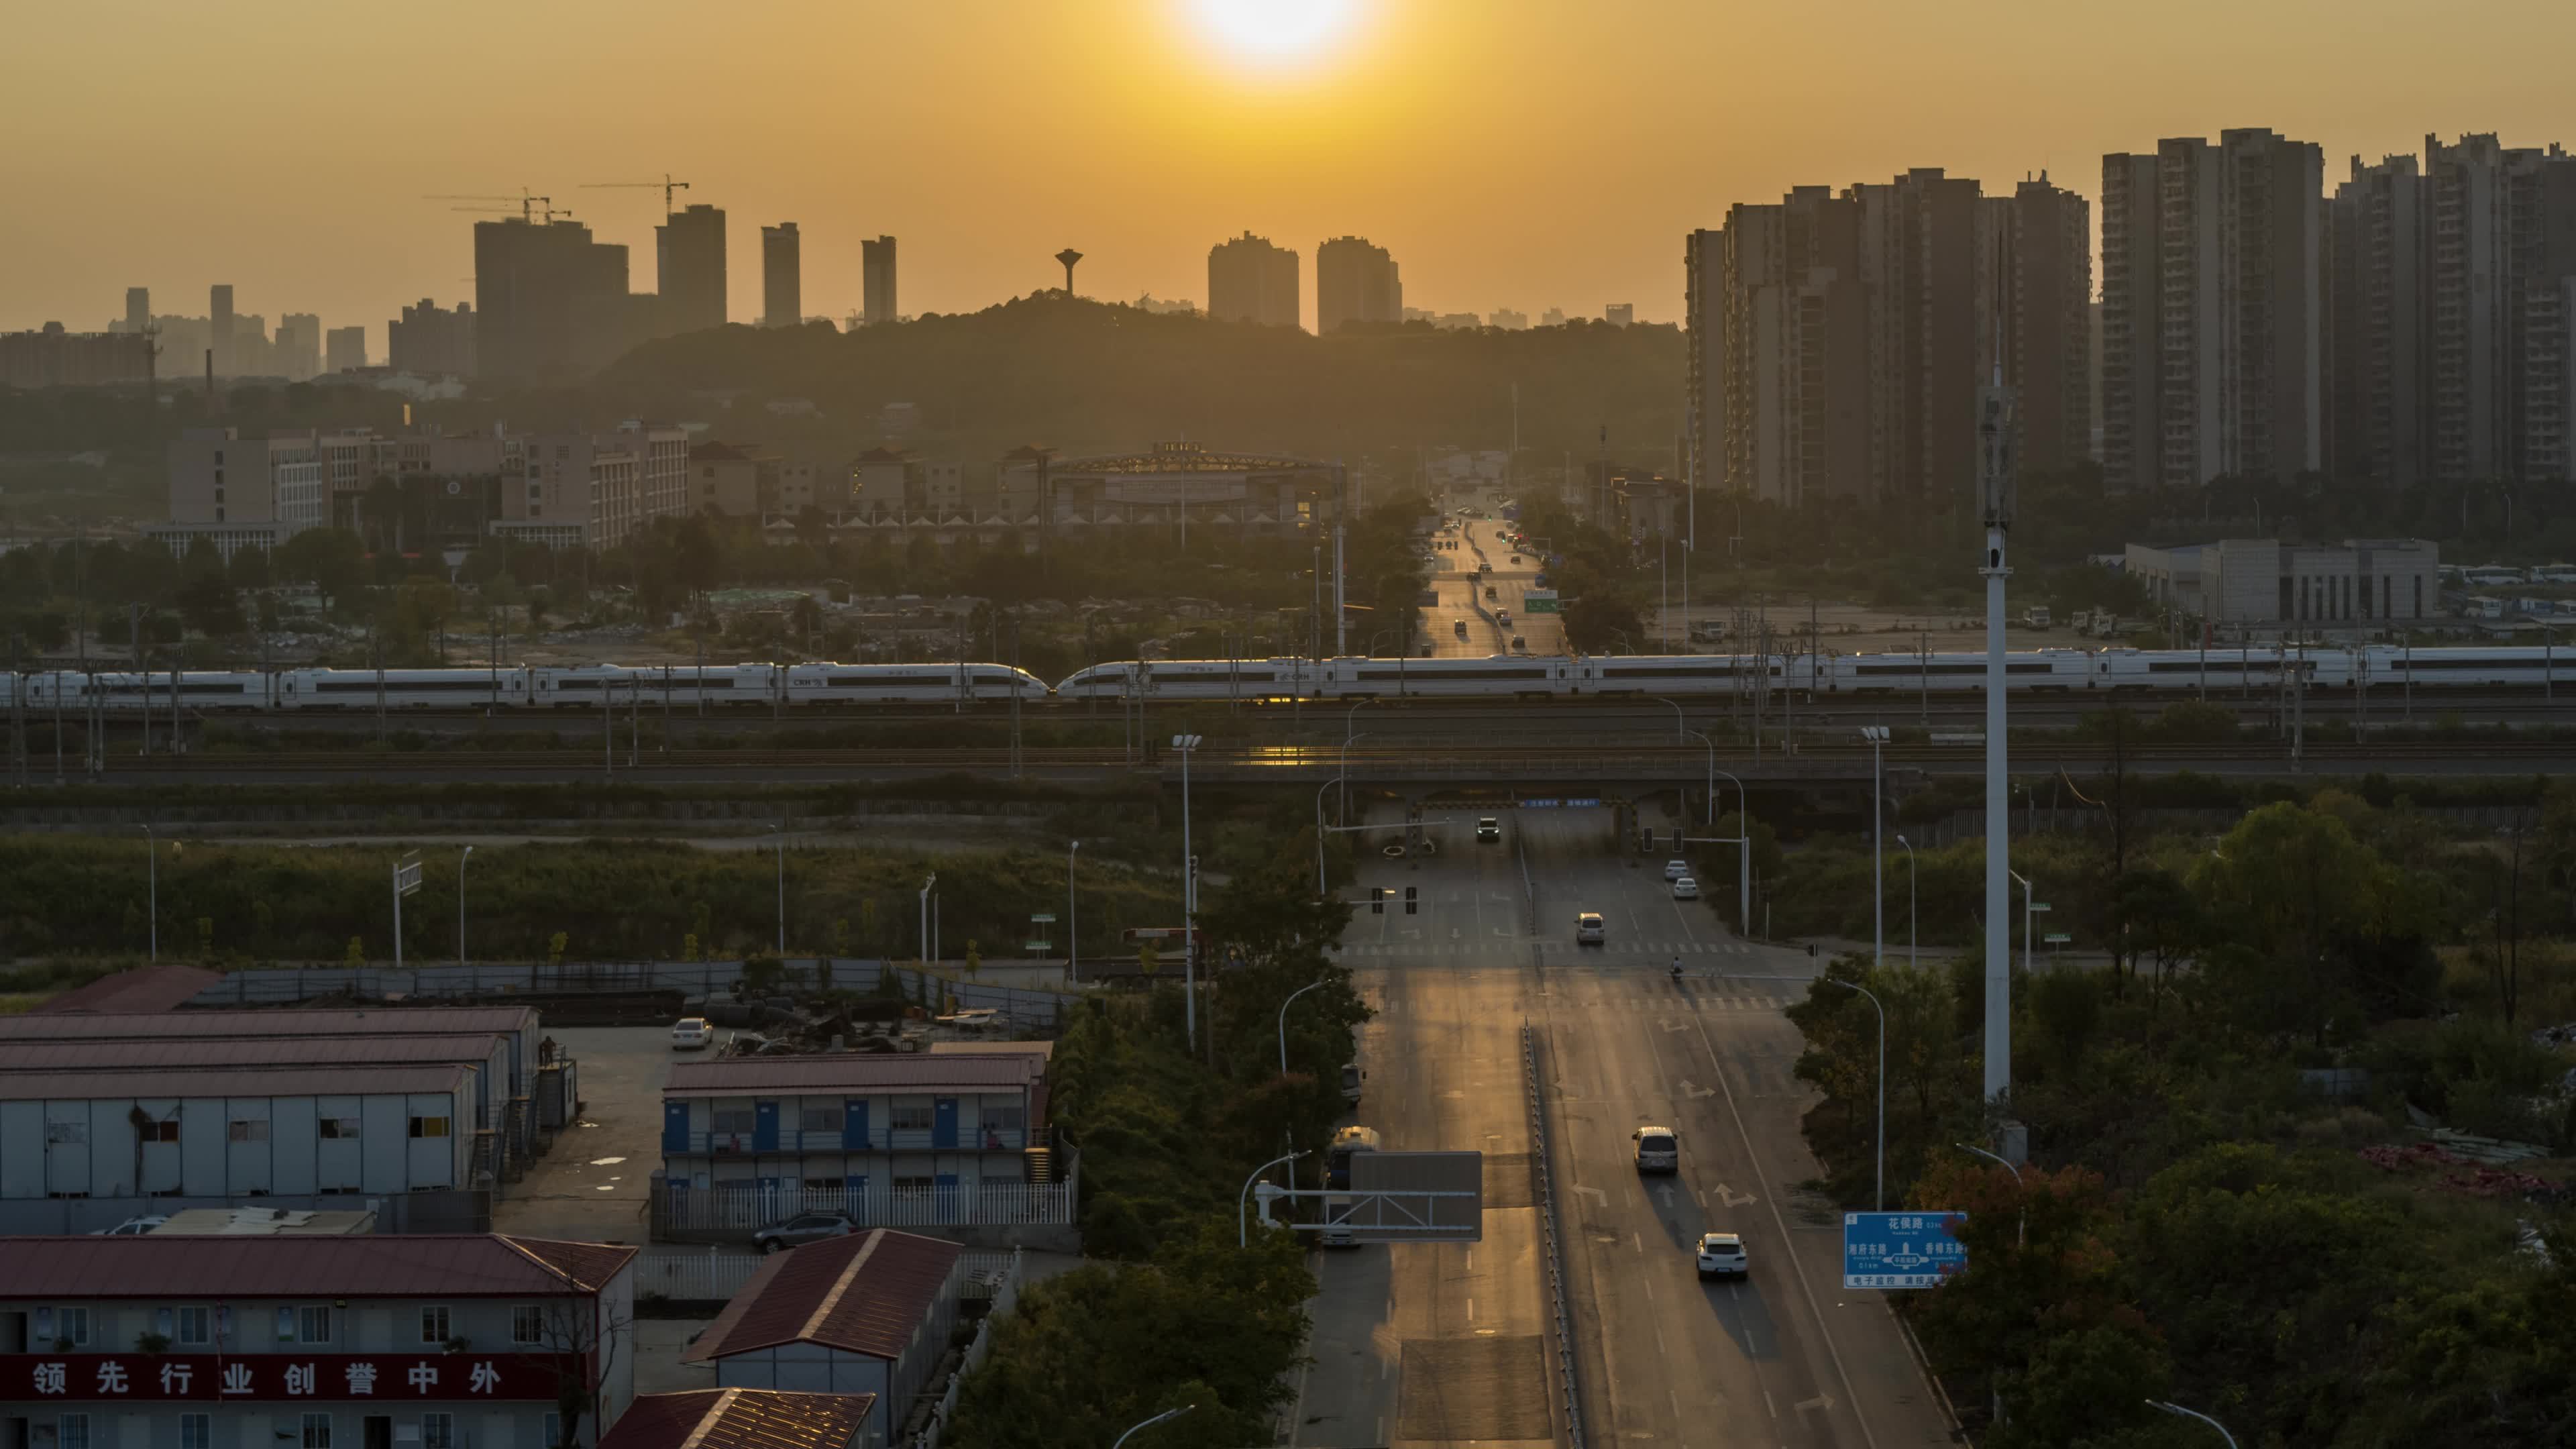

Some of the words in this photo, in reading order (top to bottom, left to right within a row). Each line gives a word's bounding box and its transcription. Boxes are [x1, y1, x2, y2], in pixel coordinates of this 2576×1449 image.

[1854, 1277, 1895, 1285] 电子监控
[34, 1362, 500, 1393] 领先行业创誉中外
